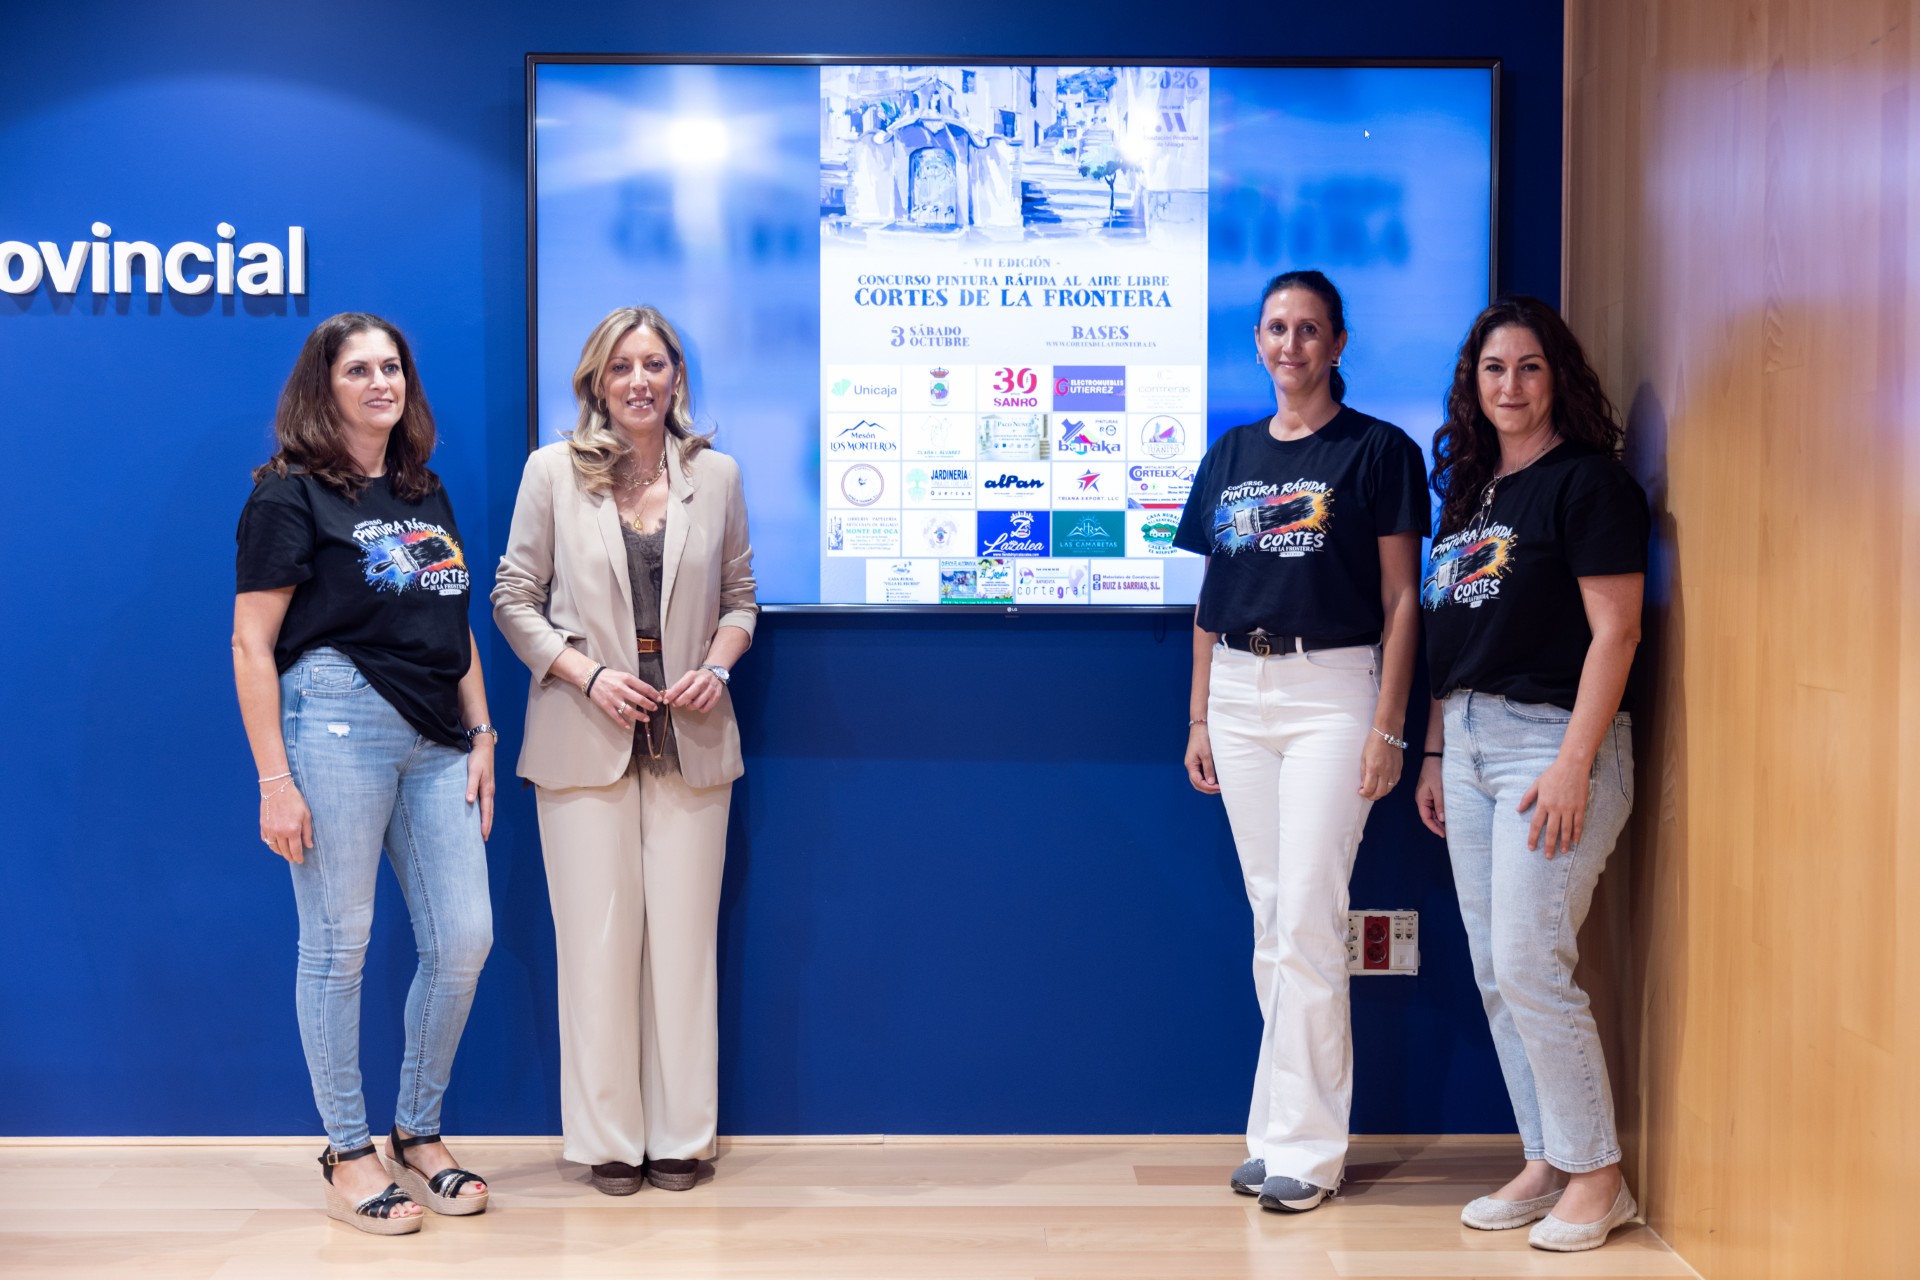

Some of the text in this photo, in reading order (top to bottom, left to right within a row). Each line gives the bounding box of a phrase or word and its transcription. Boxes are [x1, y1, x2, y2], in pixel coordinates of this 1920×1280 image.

[1146, 70, 1199, 89] 2026
[0, 221, 306, 296] ovincial
[974, 258, 993, 268] VII
[998, 255, 1051, 268] EDICIÓN
[857, 273, 1170, 286] CONCURSO PINTURA RÁPIDA AL AIRE LIBRE
[854, 287, 1172, 308] CORTES DE LA FRONTERA
[890, 325, 905, 347] 3
[909, 324, 962, 336] SÁBADO
[1071, 325, 1129, 340] BASES
[909, 336, 970, 347] OCTUBRE
[993, 367, 1037, 394] 30
[854, 384, 897, 398] Unicaja
[1138, 385, 1191, 393] contreras
[993, 397, 1038, 407] SANRO
[830, 441, 897, 452] LOS MONTEROS
[1147, 445, 1180, 453] JUANITO
[931, 467, 968, 480] JARDINERÍA
[984, 474, 1045, 489] alPan
[1227, 480, 1263, 491] CONCURSO
[1220, 478, 1327, 506] PINTURA RÁPIDA
[1146, 512, 1161, 520] CASA
[352, 517, 447, 545] PINTURA RÁPIDA
[1259, 531, 1325, 549] CORTES
[420, 568, 470, 588] CORTES
[1017, 584, 1087, 599] cortegraf
[1102, 581, 1161, 592] RUIZ & SARRIAS, S.L.
[1453, 578, 1501, 601] CORTES
